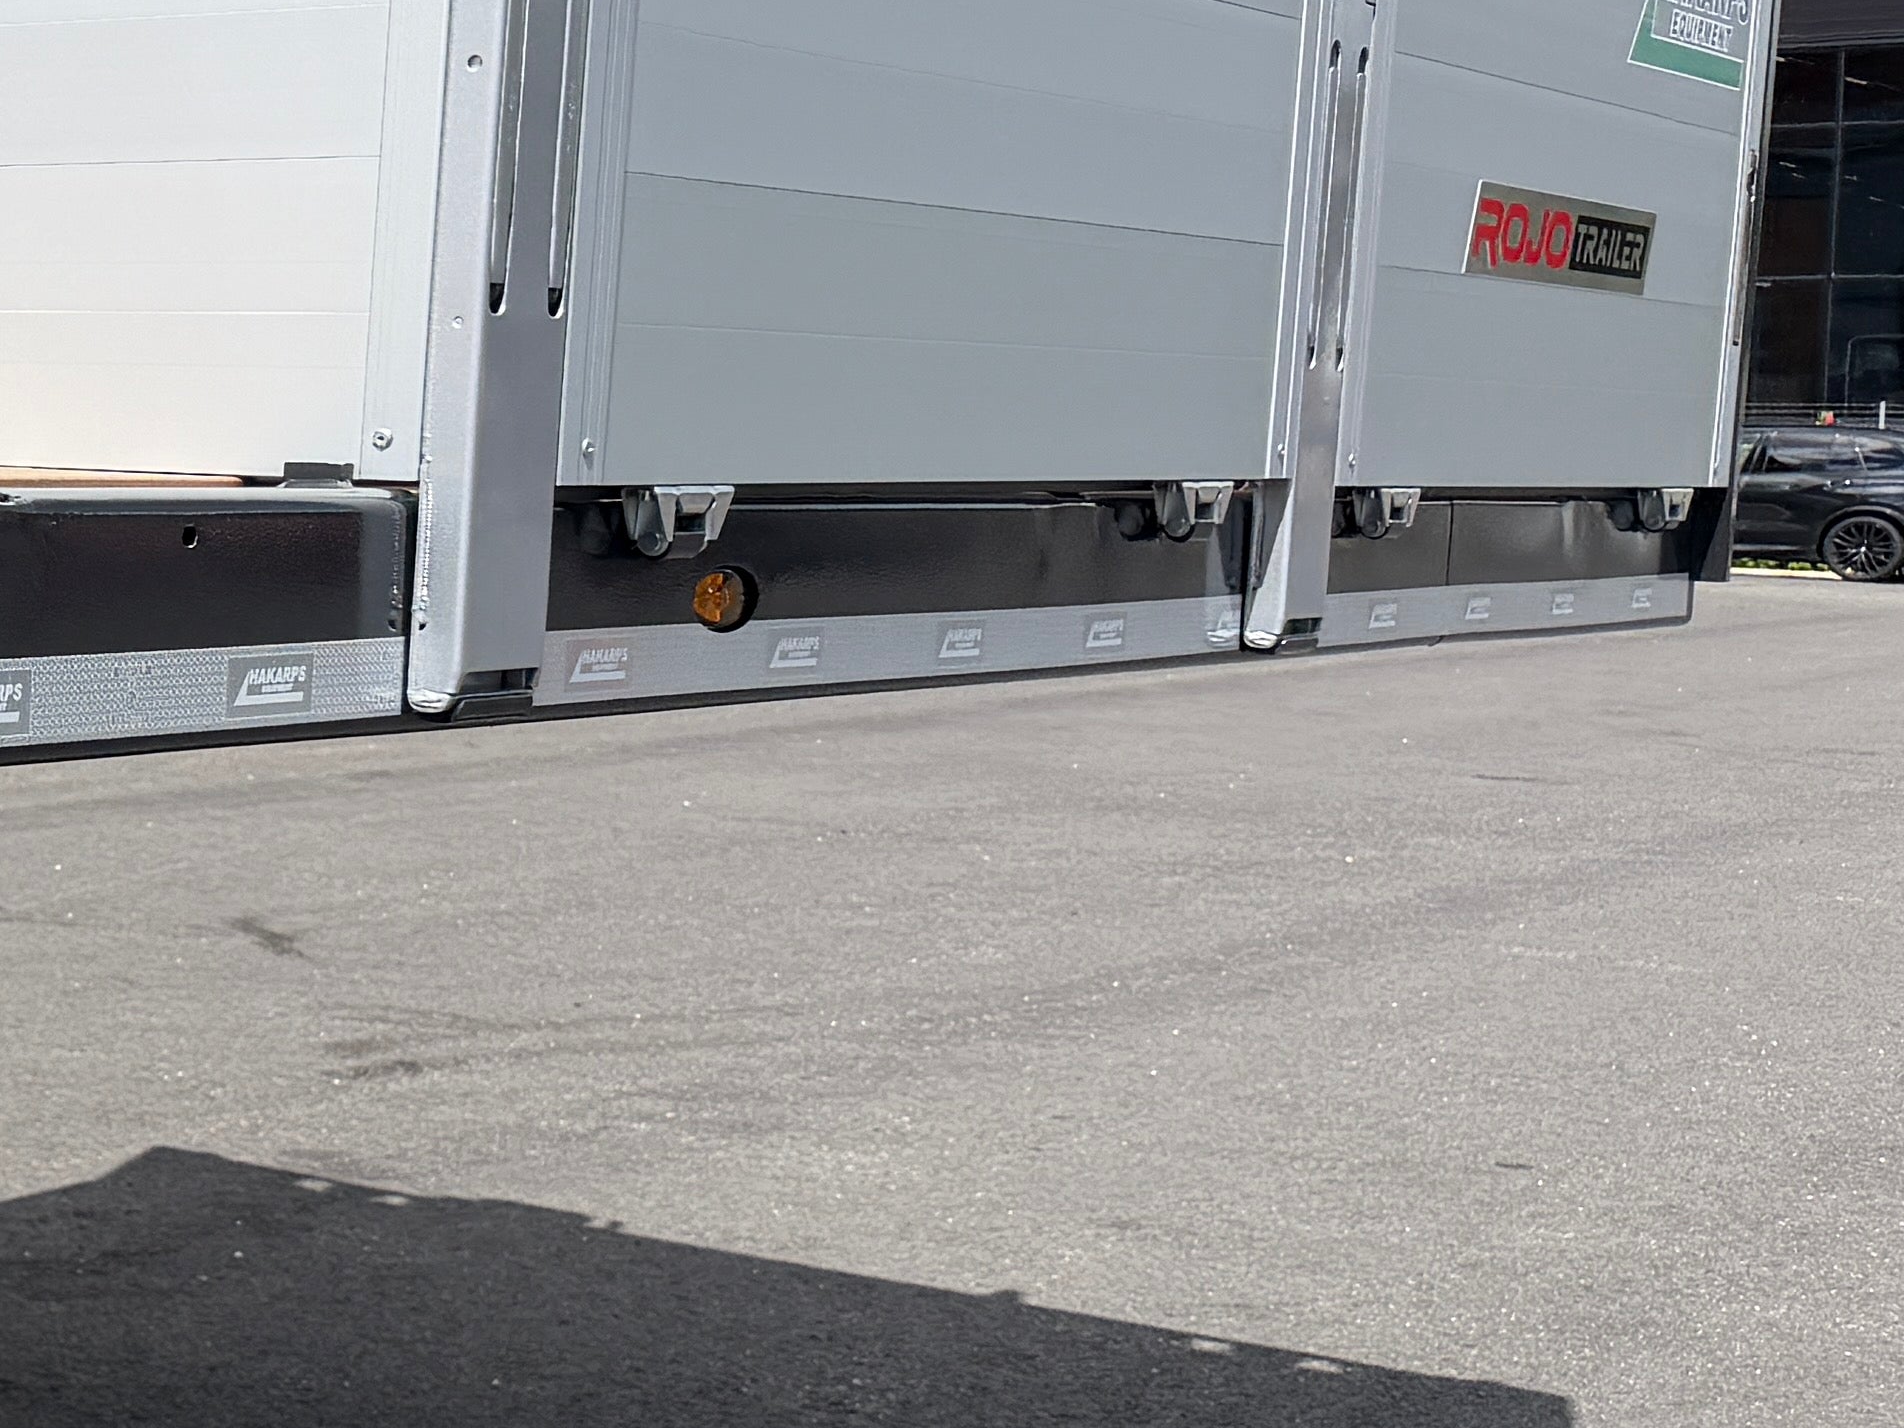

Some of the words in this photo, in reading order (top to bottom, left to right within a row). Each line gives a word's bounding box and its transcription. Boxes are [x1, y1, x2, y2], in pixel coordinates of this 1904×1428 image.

[1471, 197, 1574, 270] ROJO
[1575, 223, 1645, 272] TRAILER
[249, 665, 307, 685] HAKARPS
